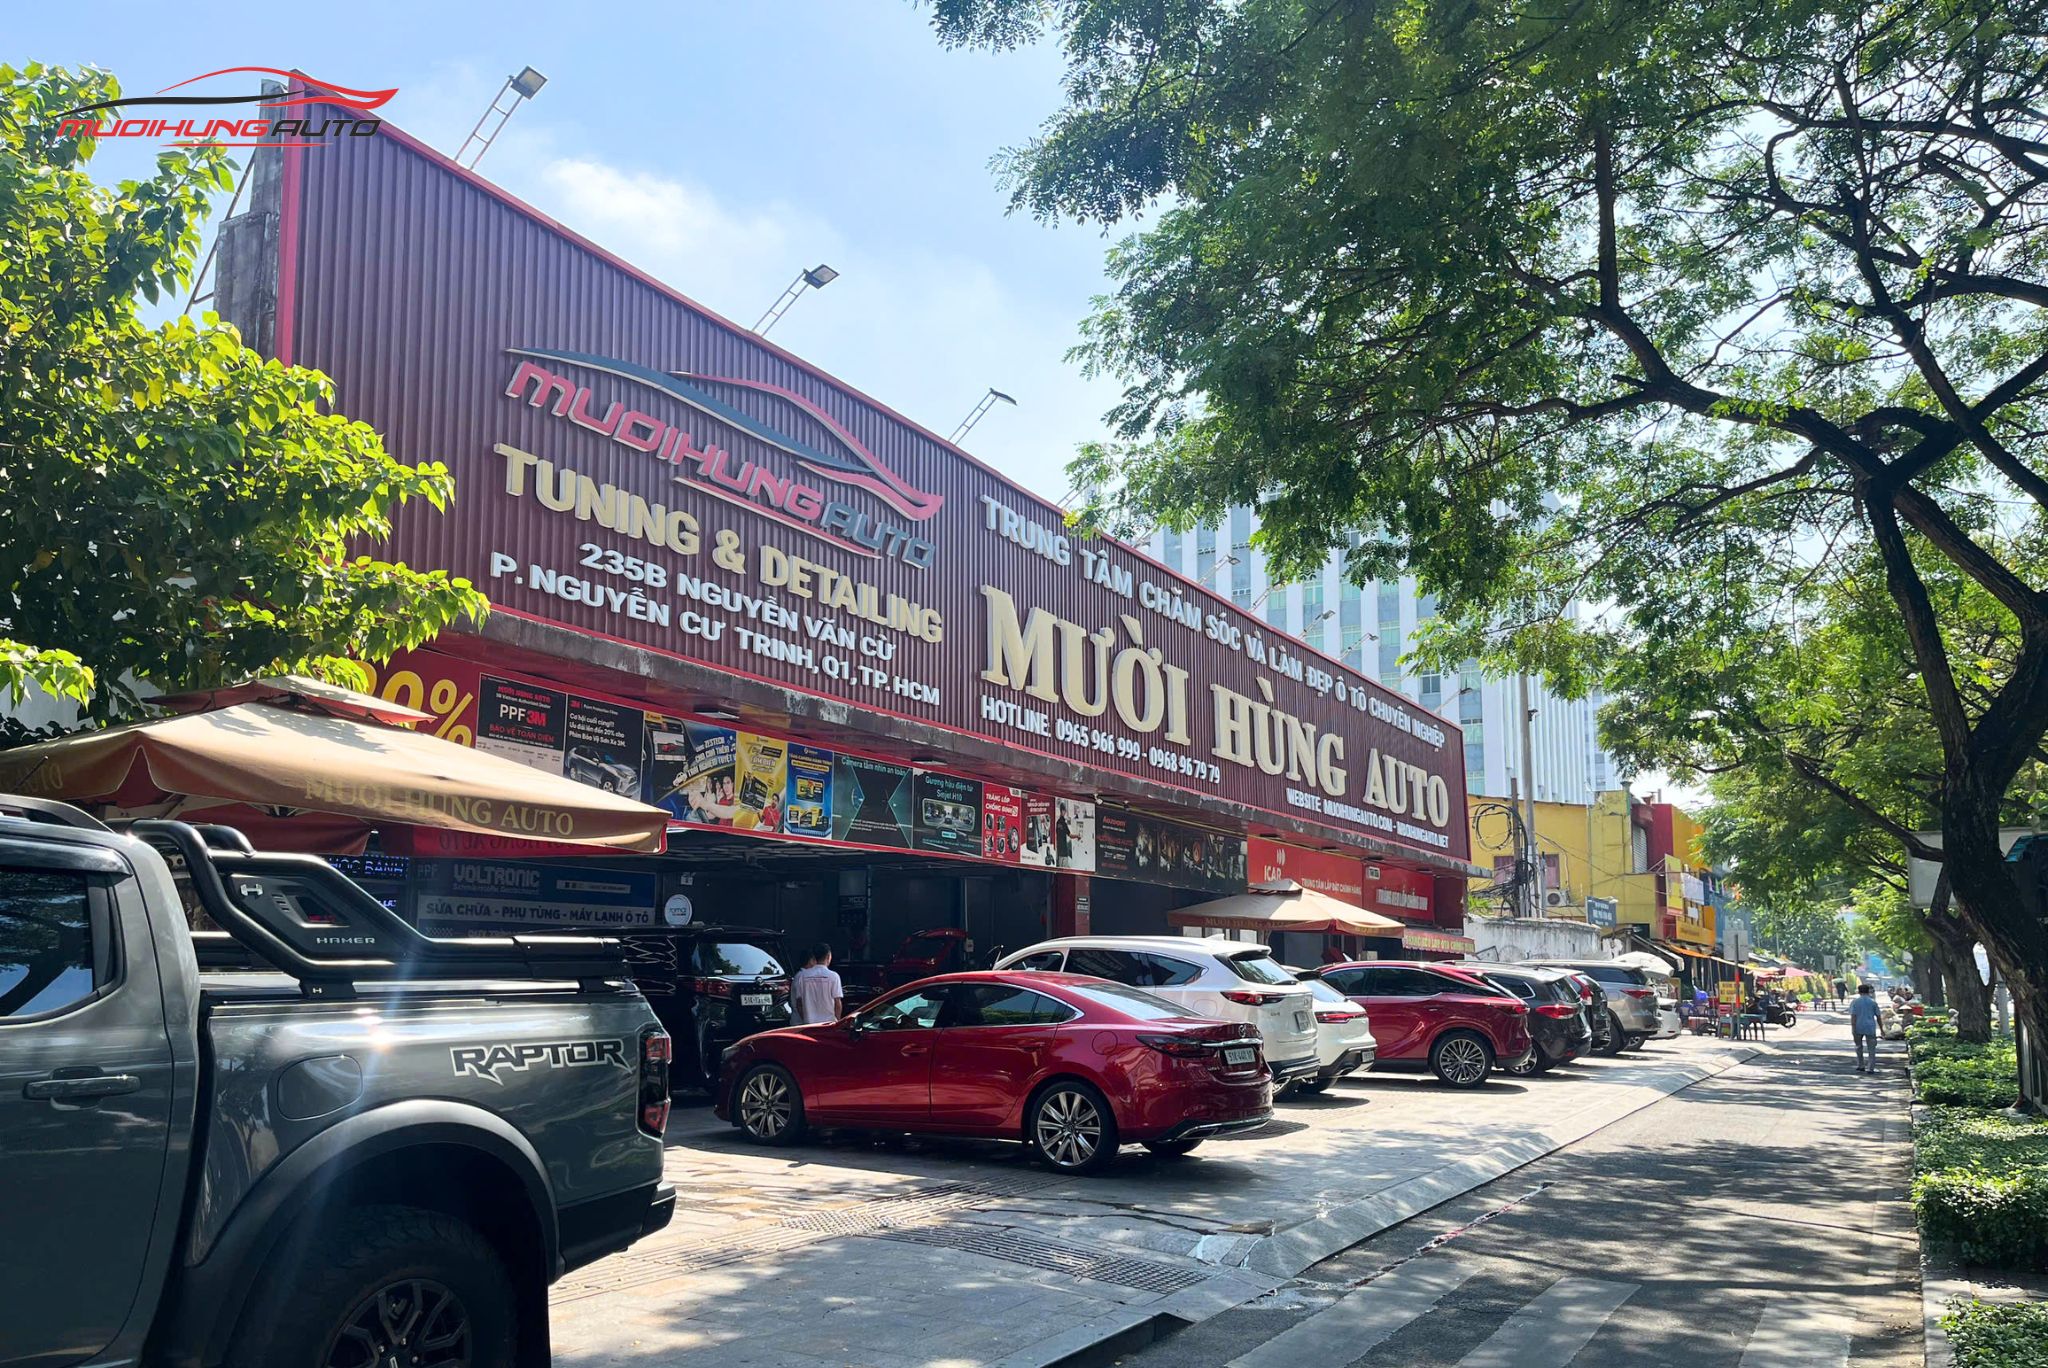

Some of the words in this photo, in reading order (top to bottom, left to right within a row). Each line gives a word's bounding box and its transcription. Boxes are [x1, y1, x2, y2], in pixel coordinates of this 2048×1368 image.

[494, 443, 700, 555] TUNING
[713, 529, 746, 575] &
[760, 545, 943, 643] DETAILING
[529, 564, 669, 627] NGUYỄN
[679, 611, 726, 641] CƯ
[579, 543, 667, 588] 235B
[677, 573, 798, 632] NGUYỄN
[803, 615, 855, 650] VĂN
[860, 633, 896, 661] CỪ
[980, 494, 1070, 566] TRUNG
[1080, 549, 1132, 599] TÂM
[1139, 581, 1202, 632] CHĂM
[1205, 612, 1241, 650] SÓC
[1244, 629, 1267, 665] VÀ
[1269, 645, 1303, 682] LÀM
[1305, 665, 1334, 698] ĐẸP
[1335, 675, 1347, 702] Ô
[1348, 686, 1367, 712] TÔ
[1369, 697, 1412, 734] CHUYÊN
[1412, 718, 1446, 752] NGHIỆP
[350, 659, 473, 748] 0%
[500, 703, 526, 722] PPF
[527, 710, 547, 727] 3M
[980, 584, 1191, 746] MƯỜI
[1210, 676, 1347, 797] HÙNG
[1363, 748, 1449, 828] AUTO
[1055, 718, 1089, 748] 0965
[1091, 730, 1114, 755] 966
[1117, 737, 1140, 761] 999
[1149, 746, 1178, 772] 0968
[1179, 758, 1193, 777] 96
[1207, 765, 1220, 784] 79
[500, 804, 574, 836] AUTO
[453, 863, 541, 887] VOLTRONIC
[1264, 865, 1282, 881] ICAR
[426, 899, 453, 916] SỬA
[456, 901, 492, 917] CHỮA
[502, 907, 527, 921] PHỤ
[529, 903, 561, 920] TÙNG
[569, 906, 593, 921] MÁY
[594, 909, 623, 925] LẠNH
[634, 908, 649, 924] TÔ
[450, 1038, 632, 1086] RAPTOR
